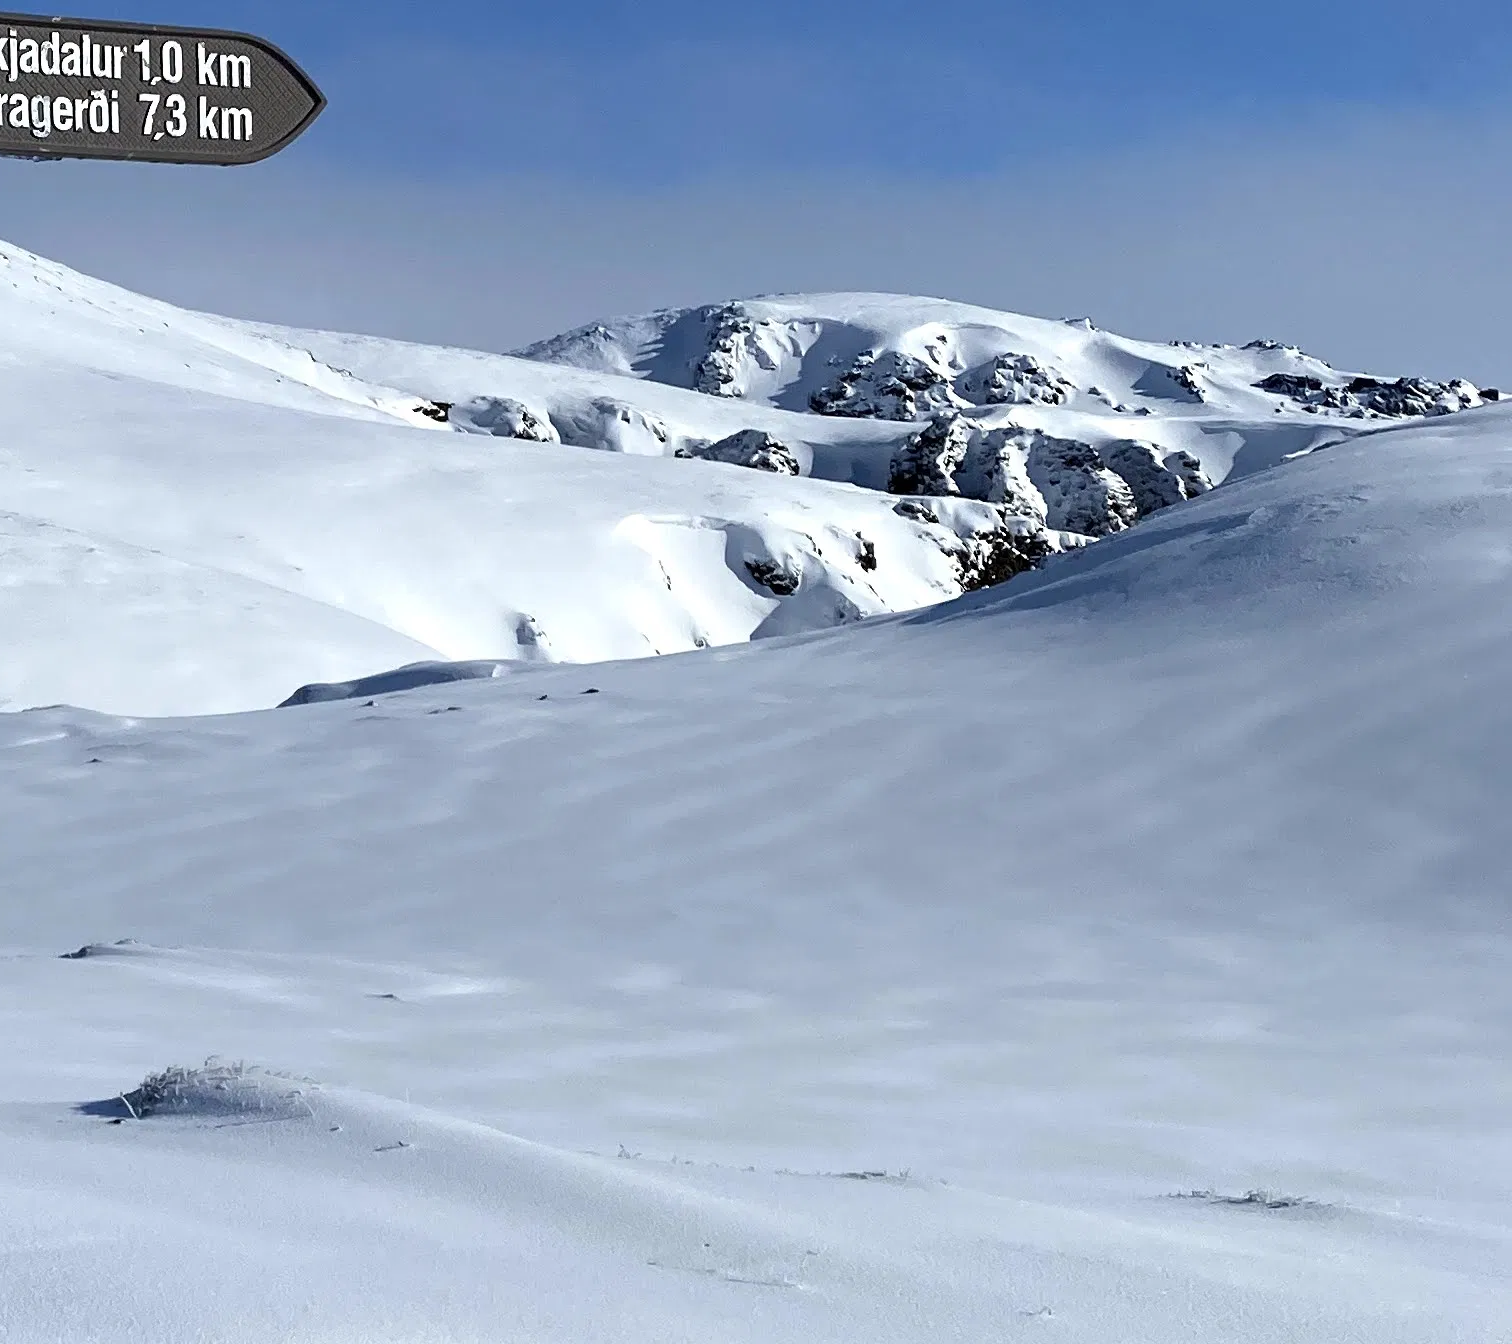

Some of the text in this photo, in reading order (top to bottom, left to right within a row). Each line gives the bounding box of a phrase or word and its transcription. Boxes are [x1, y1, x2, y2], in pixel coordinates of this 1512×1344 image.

[198, 41, 252, 89] km
[139, 93, 187, 141] 7,3
[198, 95, 253, 142] km
